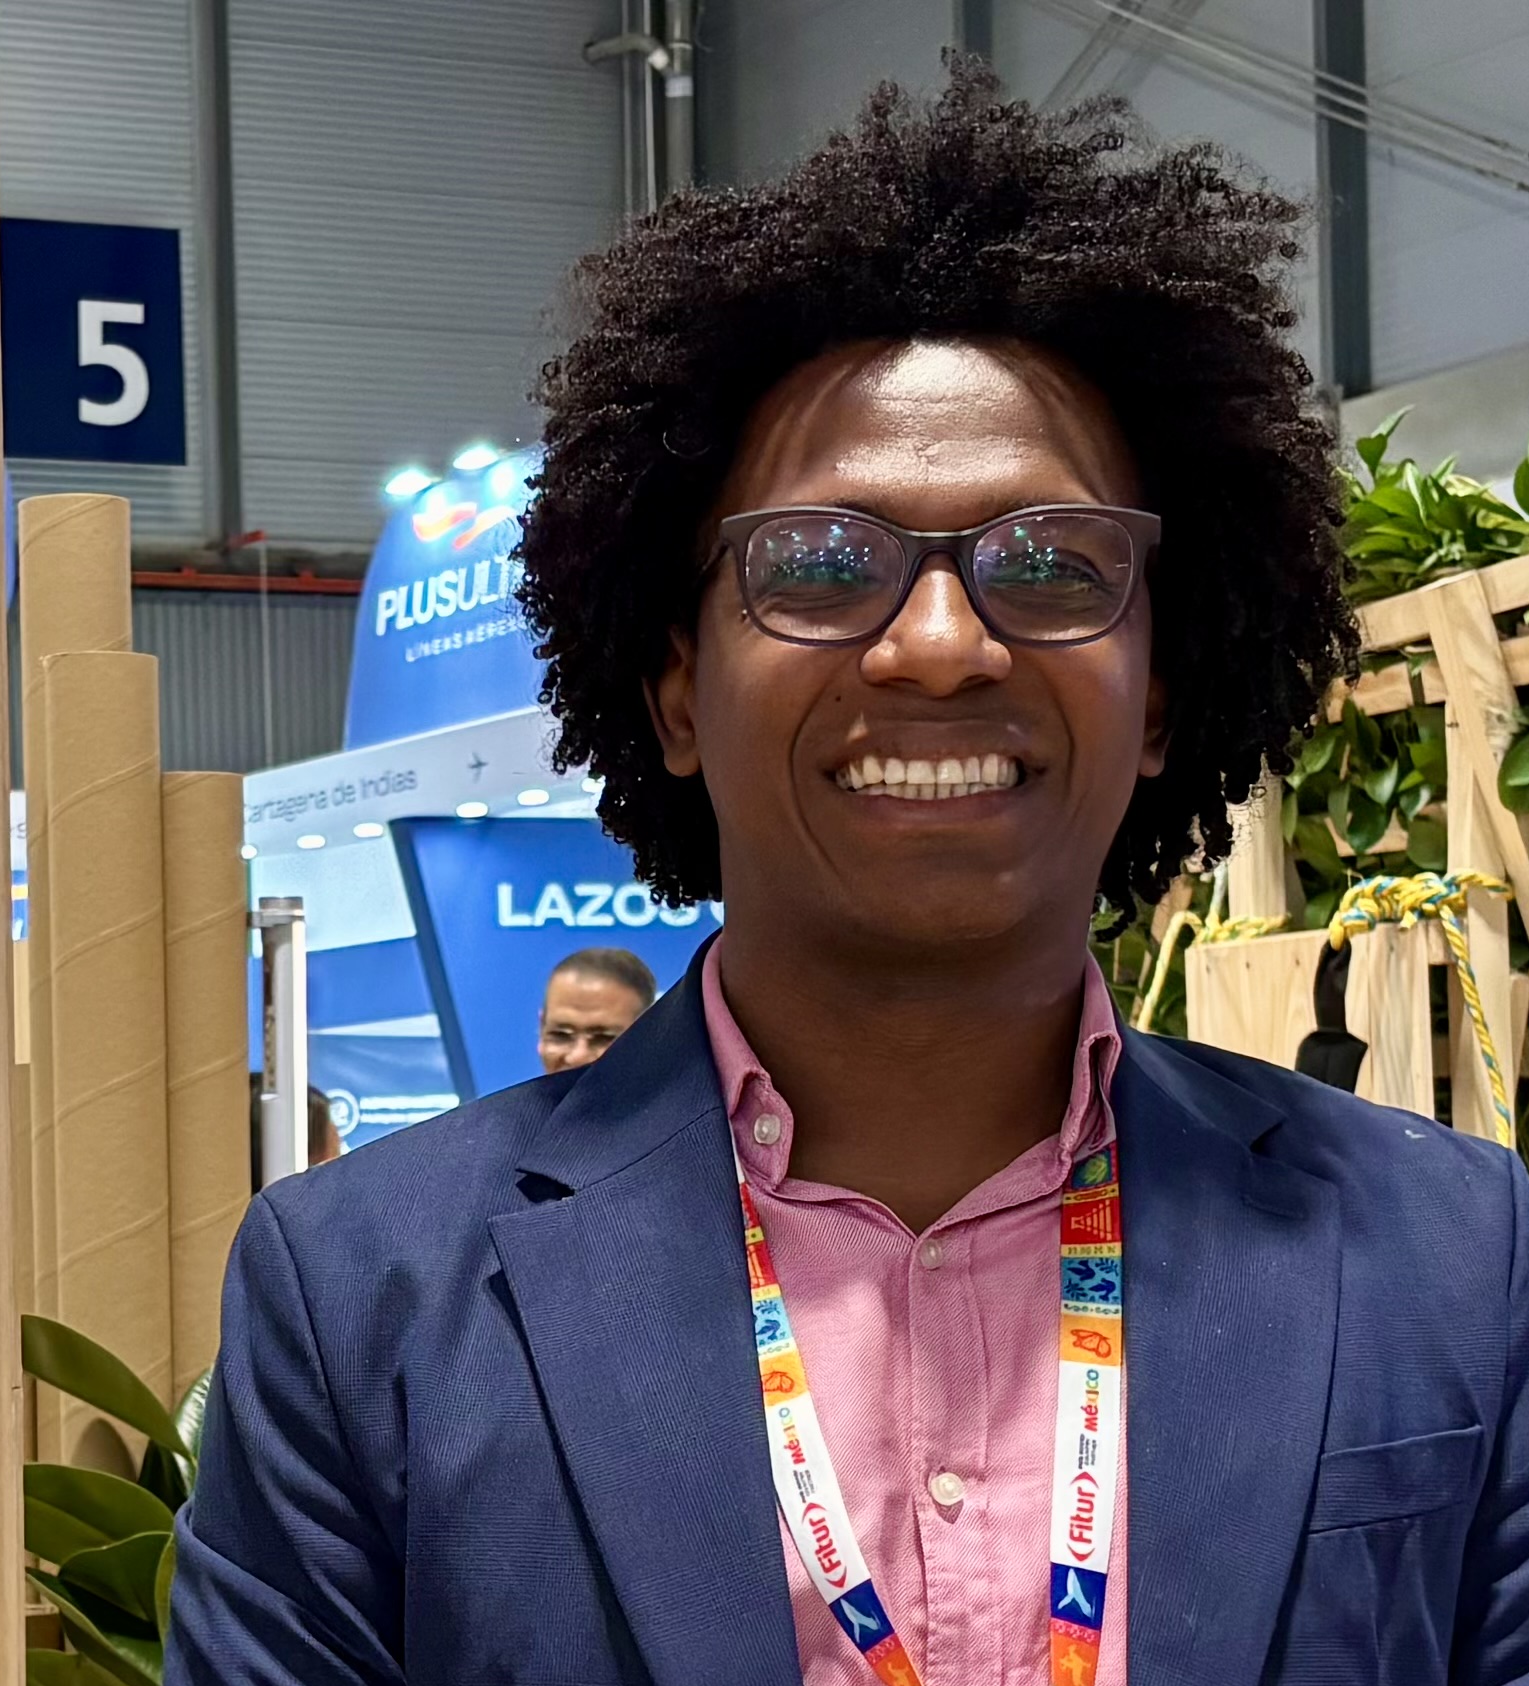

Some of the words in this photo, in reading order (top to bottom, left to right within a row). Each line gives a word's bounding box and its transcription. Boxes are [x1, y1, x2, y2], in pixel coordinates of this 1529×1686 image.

[77, 299, 150, 427] 5
[245, 789, 328, 824] artagena
[333, 780, 357, 807] de
[360, 768, 419, 800] Indias
